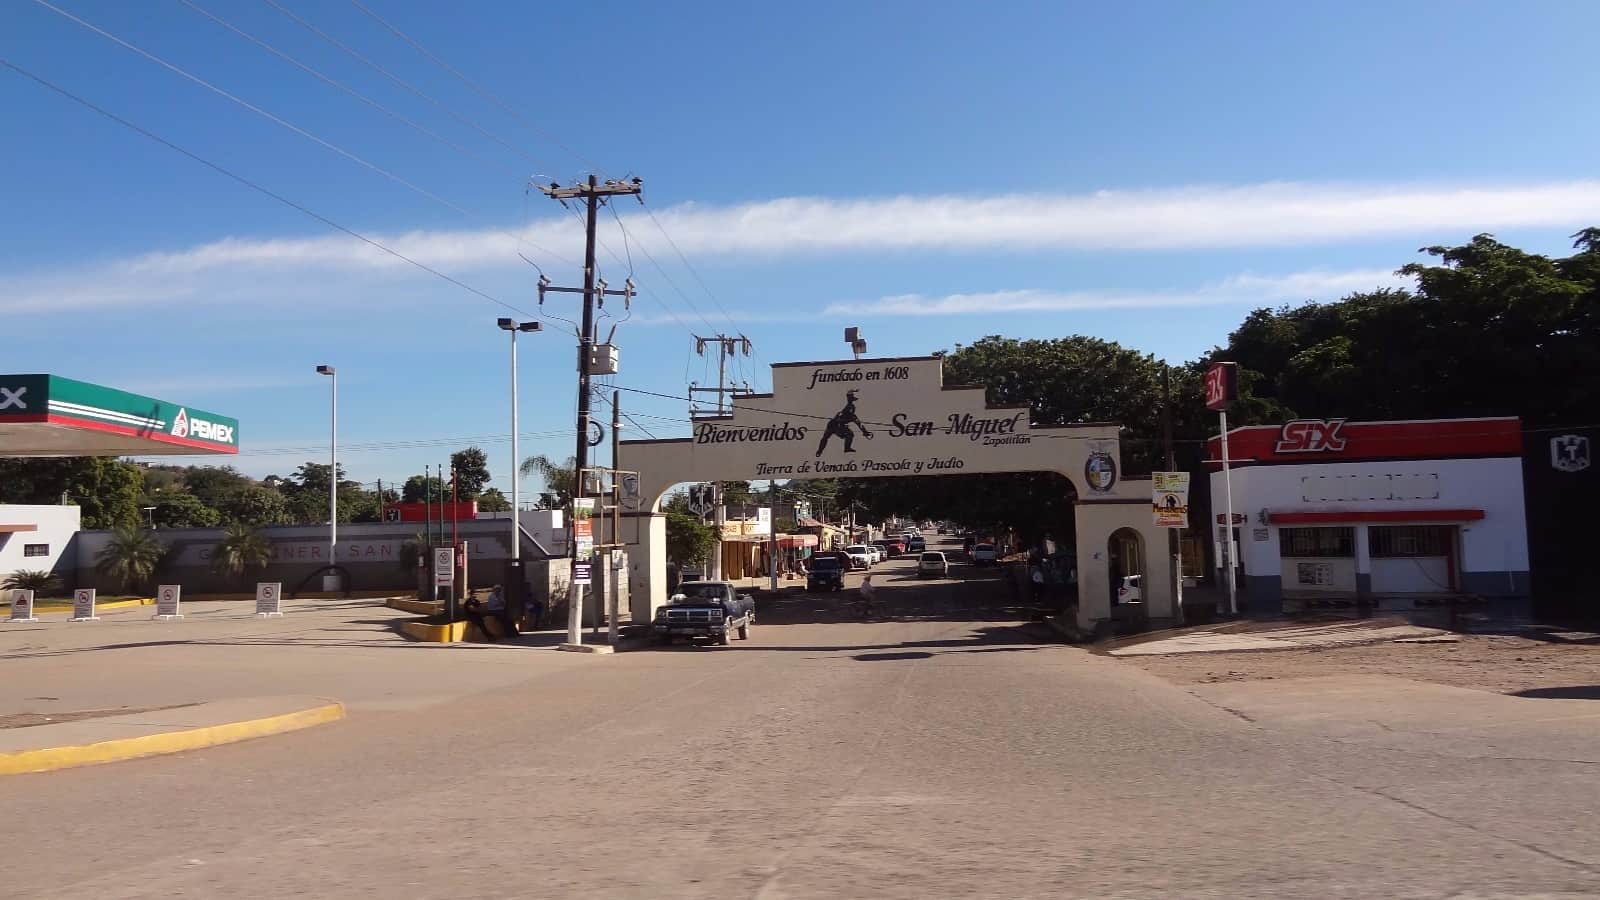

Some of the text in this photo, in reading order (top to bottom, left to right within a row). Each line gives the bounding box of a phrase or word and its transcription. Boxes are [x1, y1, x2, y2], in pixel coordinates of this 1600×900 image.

[806, 366, 910, 390] fundado en 1608
[190, 417, 234, 444] PEMEX
[694, 412, 1025, 444] Bienvenidos San Miguel
[757, 463, 793, 475] Tierra
[796, 461, 810, 473] de
[814, 460, 857, 472] Venado
[861, 458, 911, 471] Pascola
[914, 462, 924, 473] y
[350, 544, 391, 557] SAN
